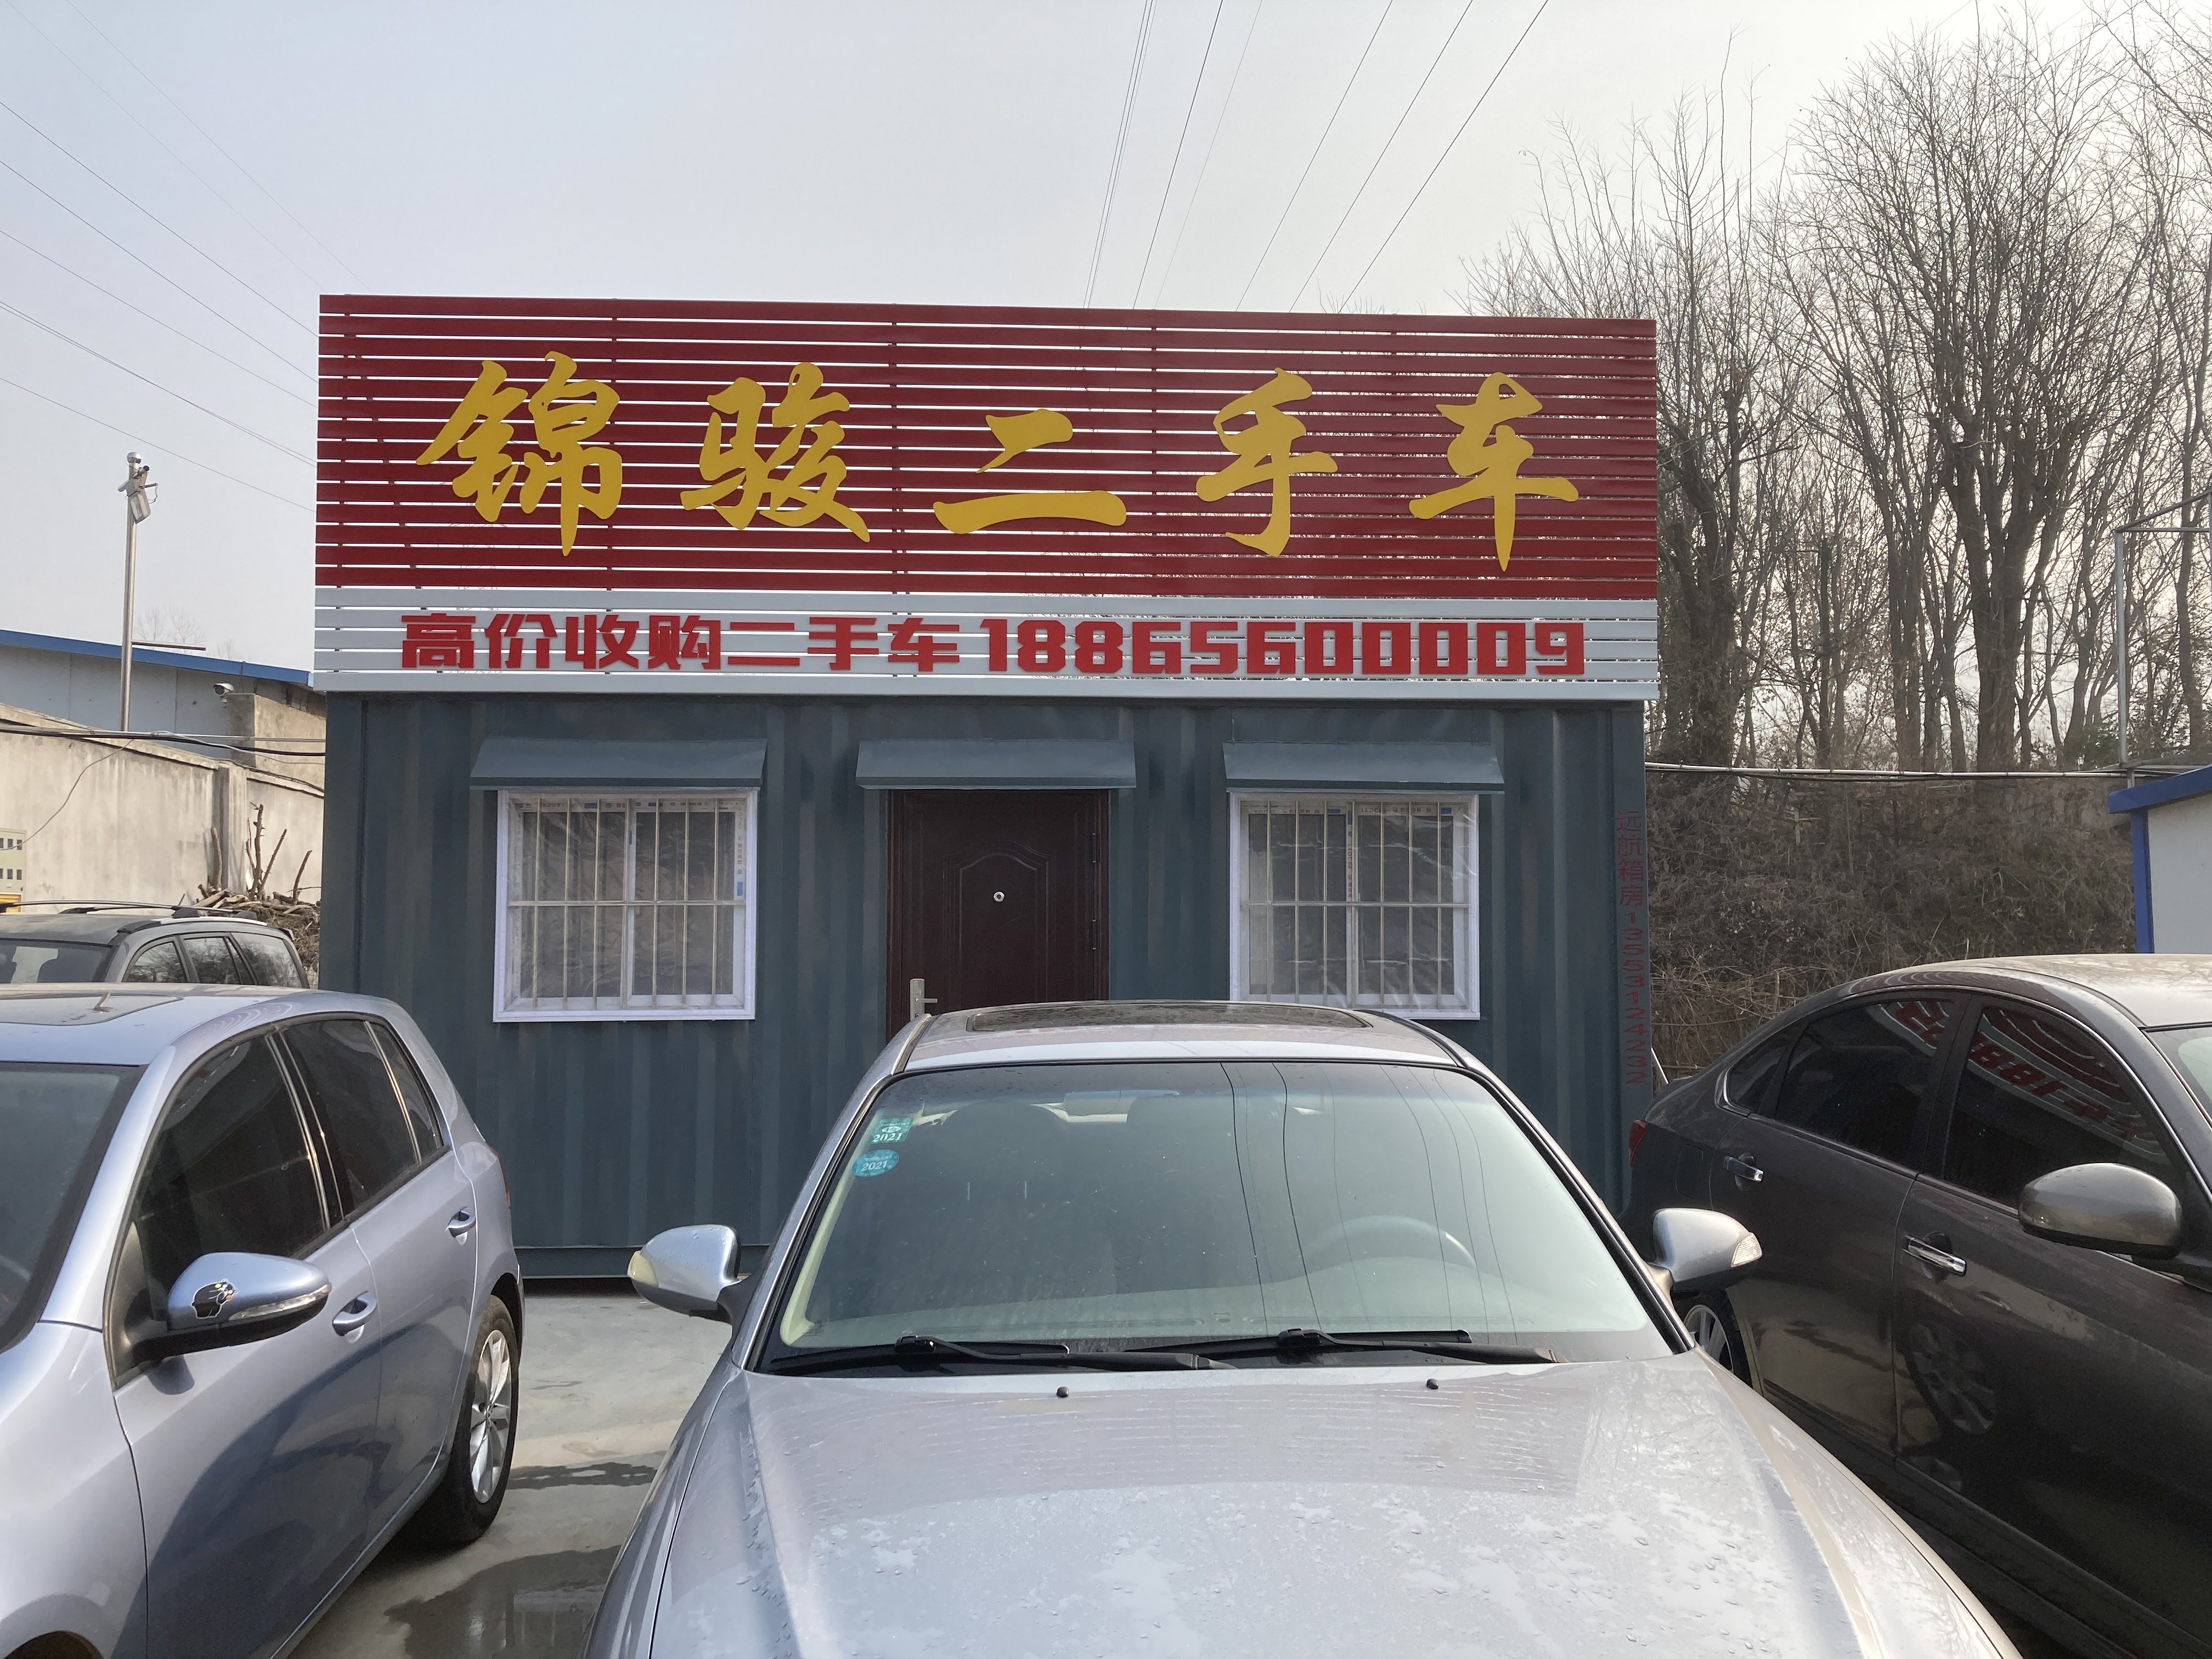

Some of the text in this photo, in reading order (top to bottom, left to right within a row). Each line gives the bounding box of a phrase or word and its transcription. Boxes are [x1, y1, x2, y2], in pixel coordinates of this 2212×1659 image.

[416, 350, 1580, 573] 锦骏二手车
[402, 613, 1584, 674] 高价收购二手车 18865600009
[871, 1132, 903, 1142] 2021
[861, 1160, 888, 1172] 2021
